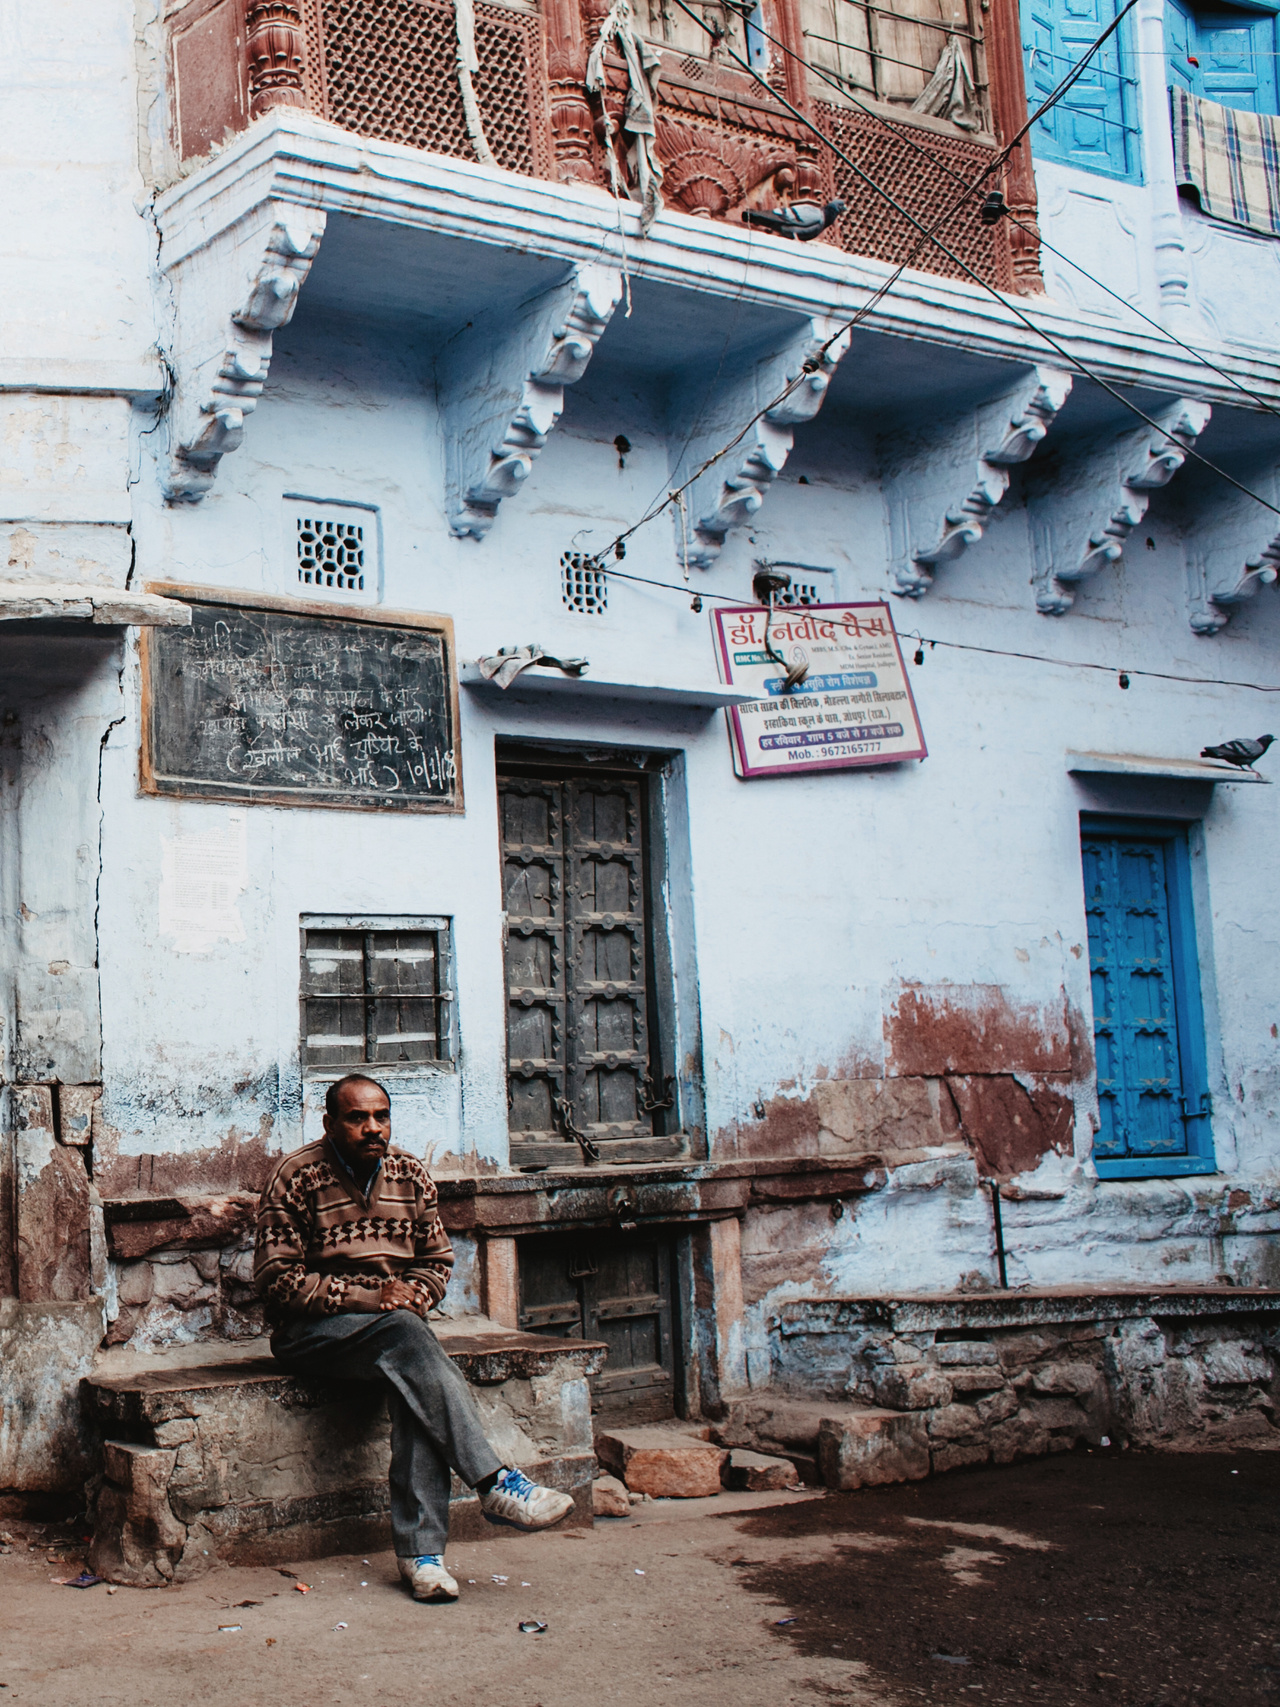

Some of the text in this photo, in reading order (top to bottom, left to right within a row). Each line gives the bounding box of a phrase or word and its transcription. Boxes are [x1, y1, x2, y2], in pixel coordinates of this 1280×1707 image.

[728, 615, 762, 645] डॉ.
[841, 708, 867, 724] जोधपुर
[760, 737, 772, 748] हर
[826, 731, 833, 740] 5
[834, 728, 850, 740] बजे
[869, 725, 885, 736] बजे
[885, 724, 901, 734] तक
[787, 748, 815, 761] Mob.
[819, 741, 882, 757] 9672165777
